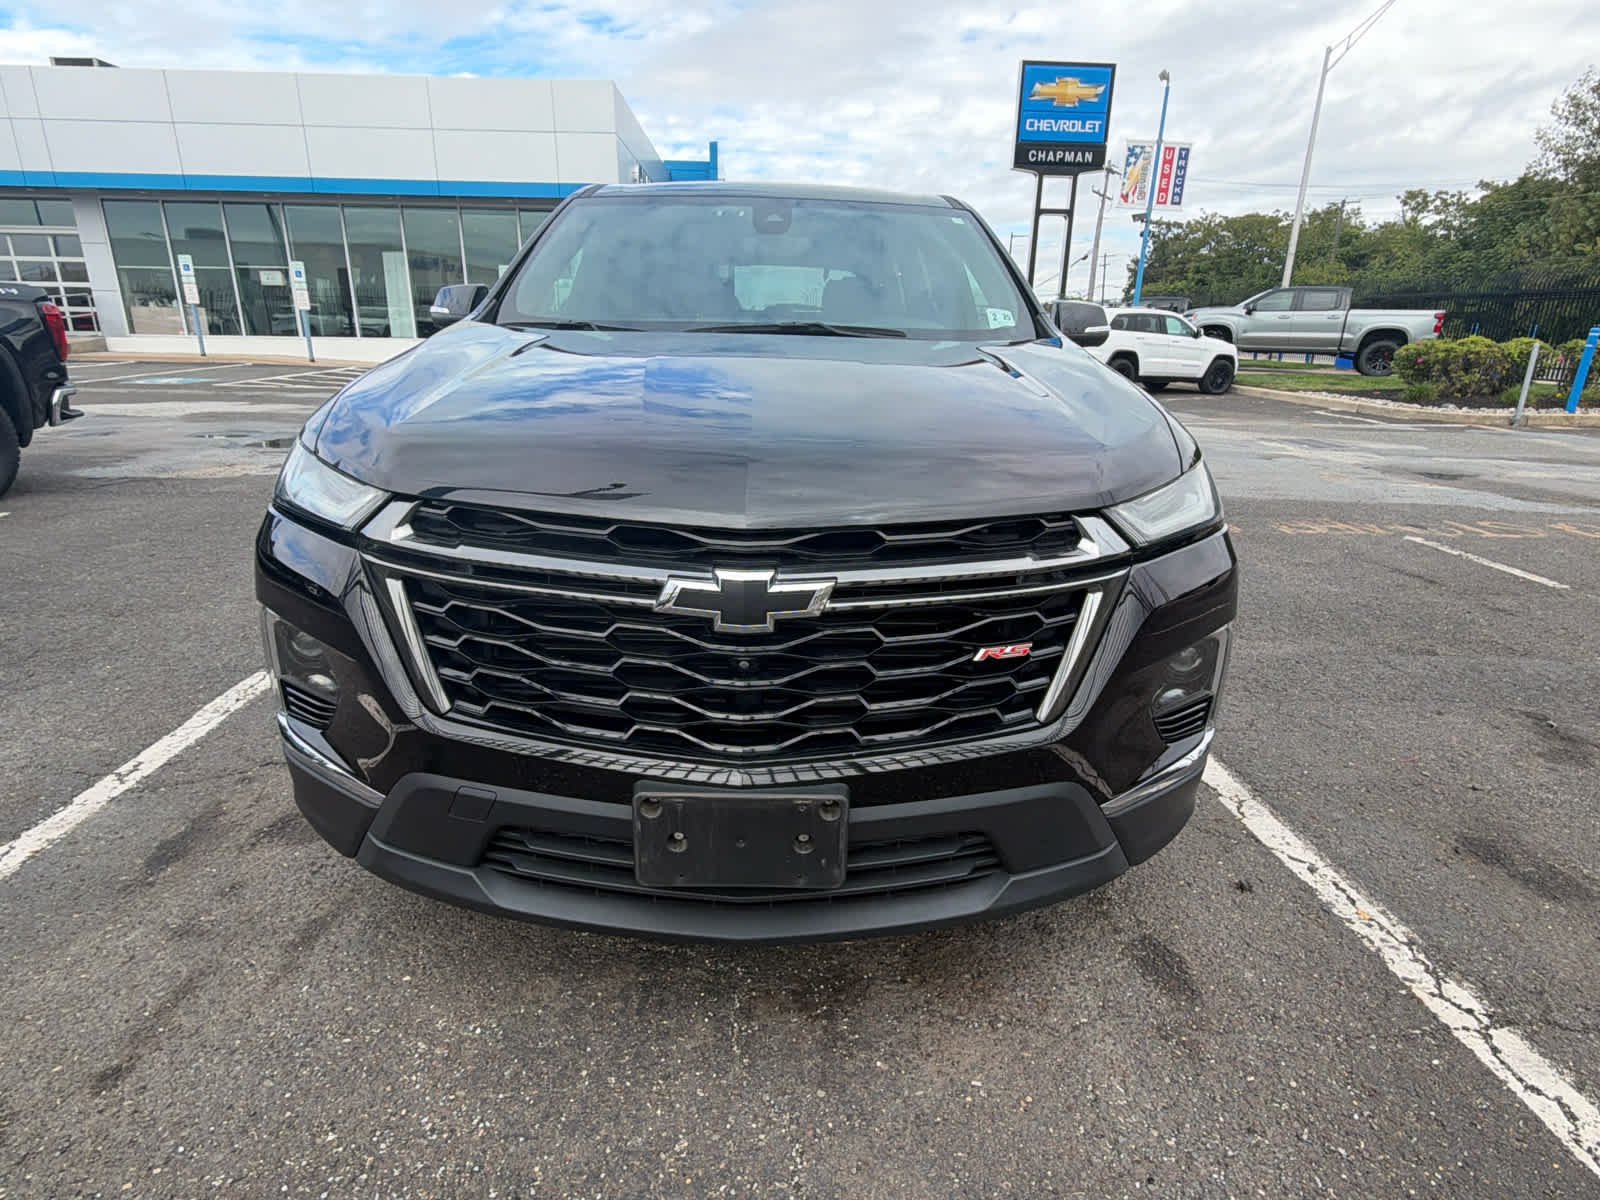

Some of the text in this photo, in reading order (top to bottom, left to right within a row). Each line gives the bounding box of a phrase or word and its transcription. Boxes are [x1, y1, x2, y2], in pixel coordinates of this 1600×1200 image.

[1025, 118, 1102, 133] CHEVROLET
[1028, 149, 1094, 163] CHAPMAN
[1158, 149, 1173, 202] USED
[1173, 150, 1187, 202] TRUCKS
[973, 643, 1033, 661] RS
